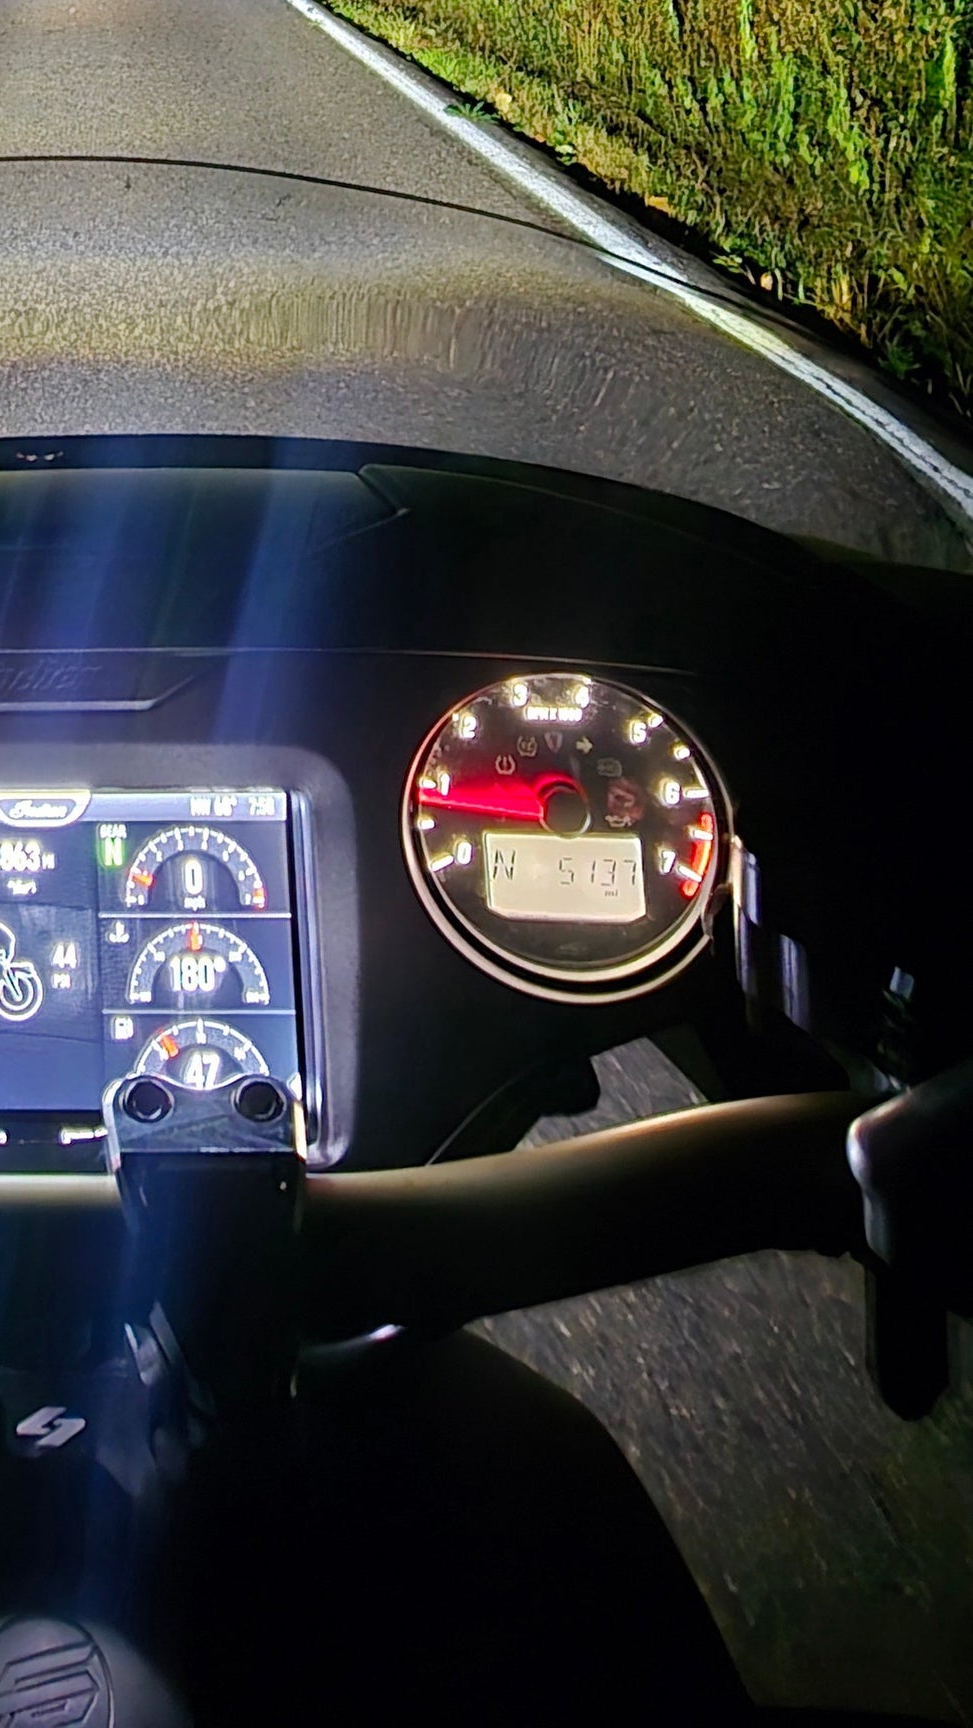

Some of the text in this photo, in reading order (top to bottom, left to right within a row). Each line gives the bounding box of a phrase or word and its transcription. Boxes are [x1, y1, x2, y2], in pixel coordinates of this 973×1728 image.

[511, 683, 528, 706] 3
[460, 716, 477, 739] 2
[630, 722, 646, 744] 5
[439, 773, 450, 796] 1
[663, 781, 680, 805] 6
[105, 838, 123, 866] N
[456, 842, 472, 864] 0
[661, 850, 675, 873] 7
[185, 859, 203, 895] 0
[492, 849, 637, 887] N 5137
[52, 943, 77, 969] 44
[169, 956, 226, 991] 180°
[186, 1052, 221, 1089] 47
